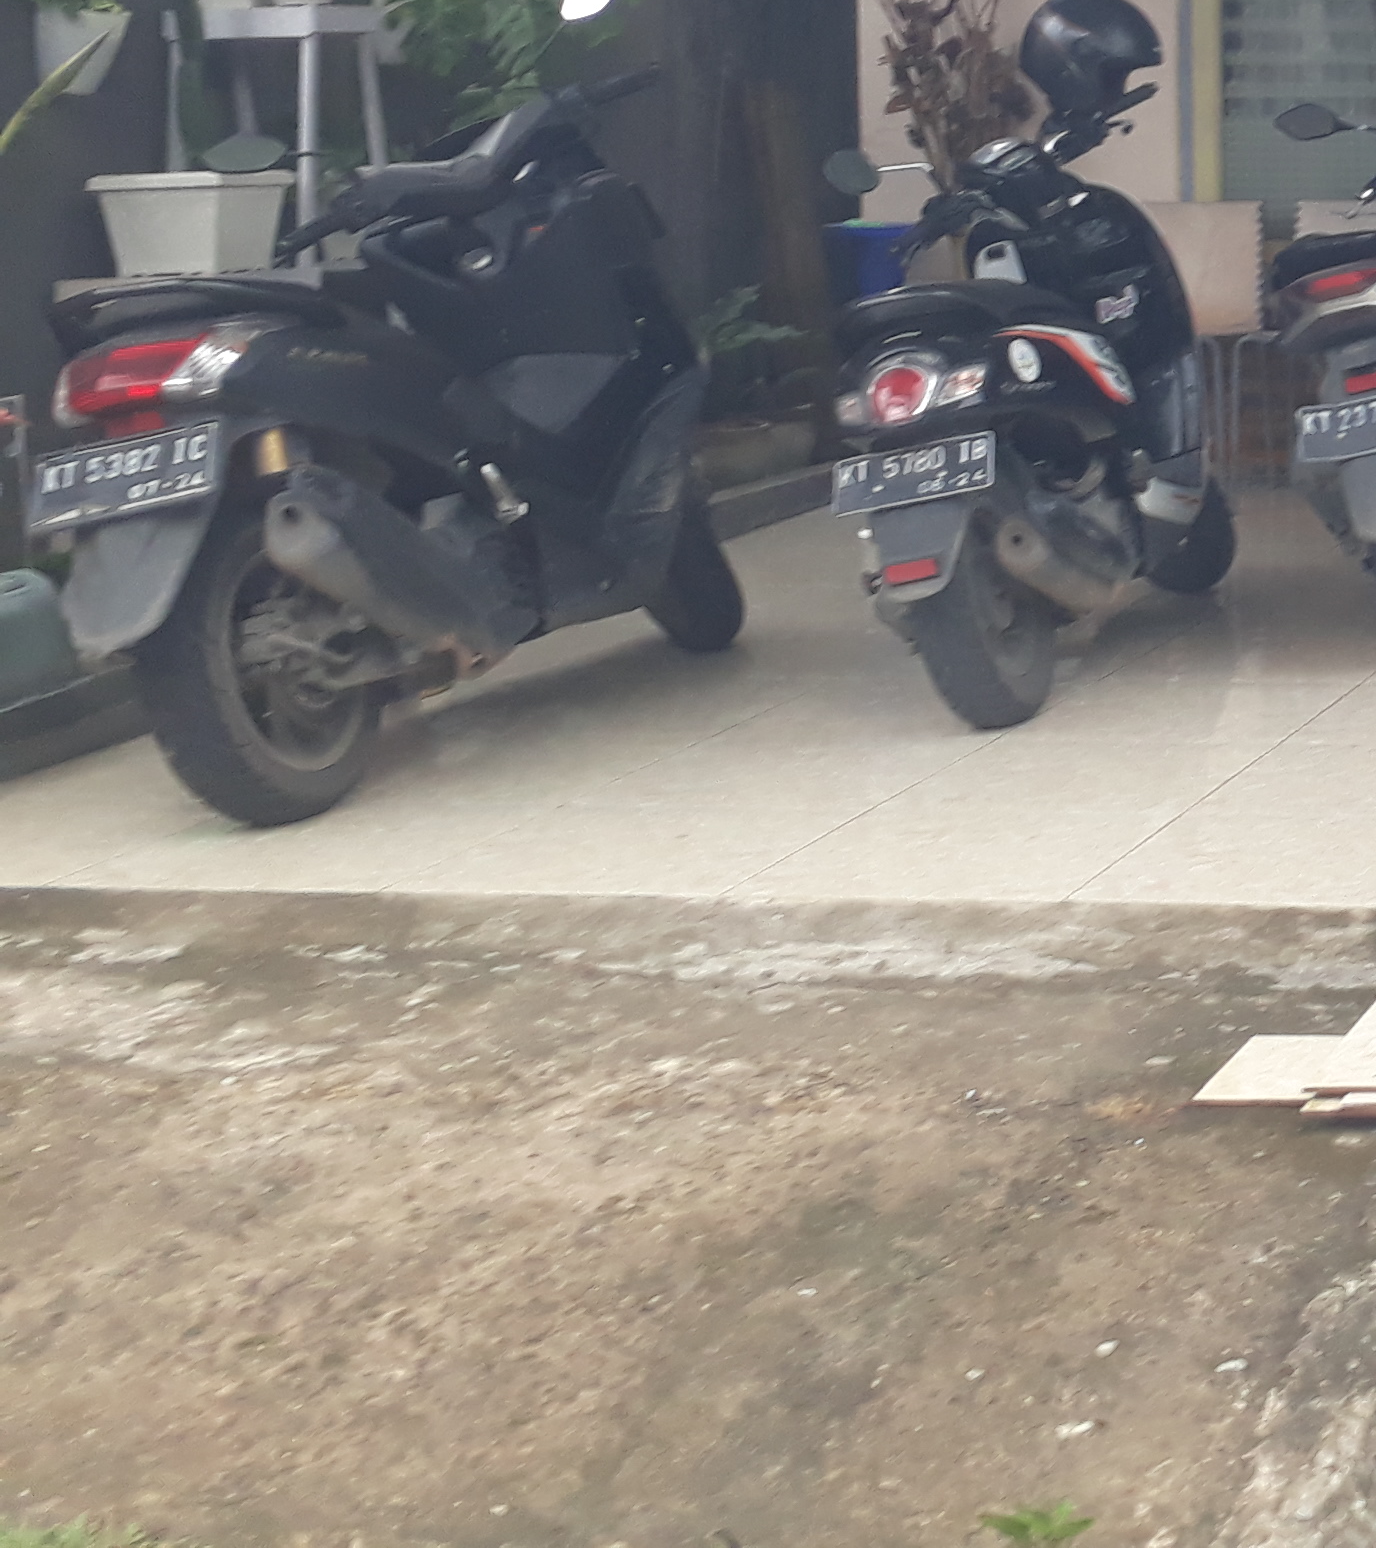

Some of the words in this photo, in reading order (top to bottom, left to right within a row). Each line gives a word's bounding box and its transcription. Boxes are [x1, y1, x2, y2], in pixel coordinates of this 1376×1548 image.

[41, 460, 81, 494] KT
[84, 443, 162, 483] 5382
[172, 434, 208, 465] IC
[838, 459, 870, 489] KT
[882, 445, 947, 479] 5780
